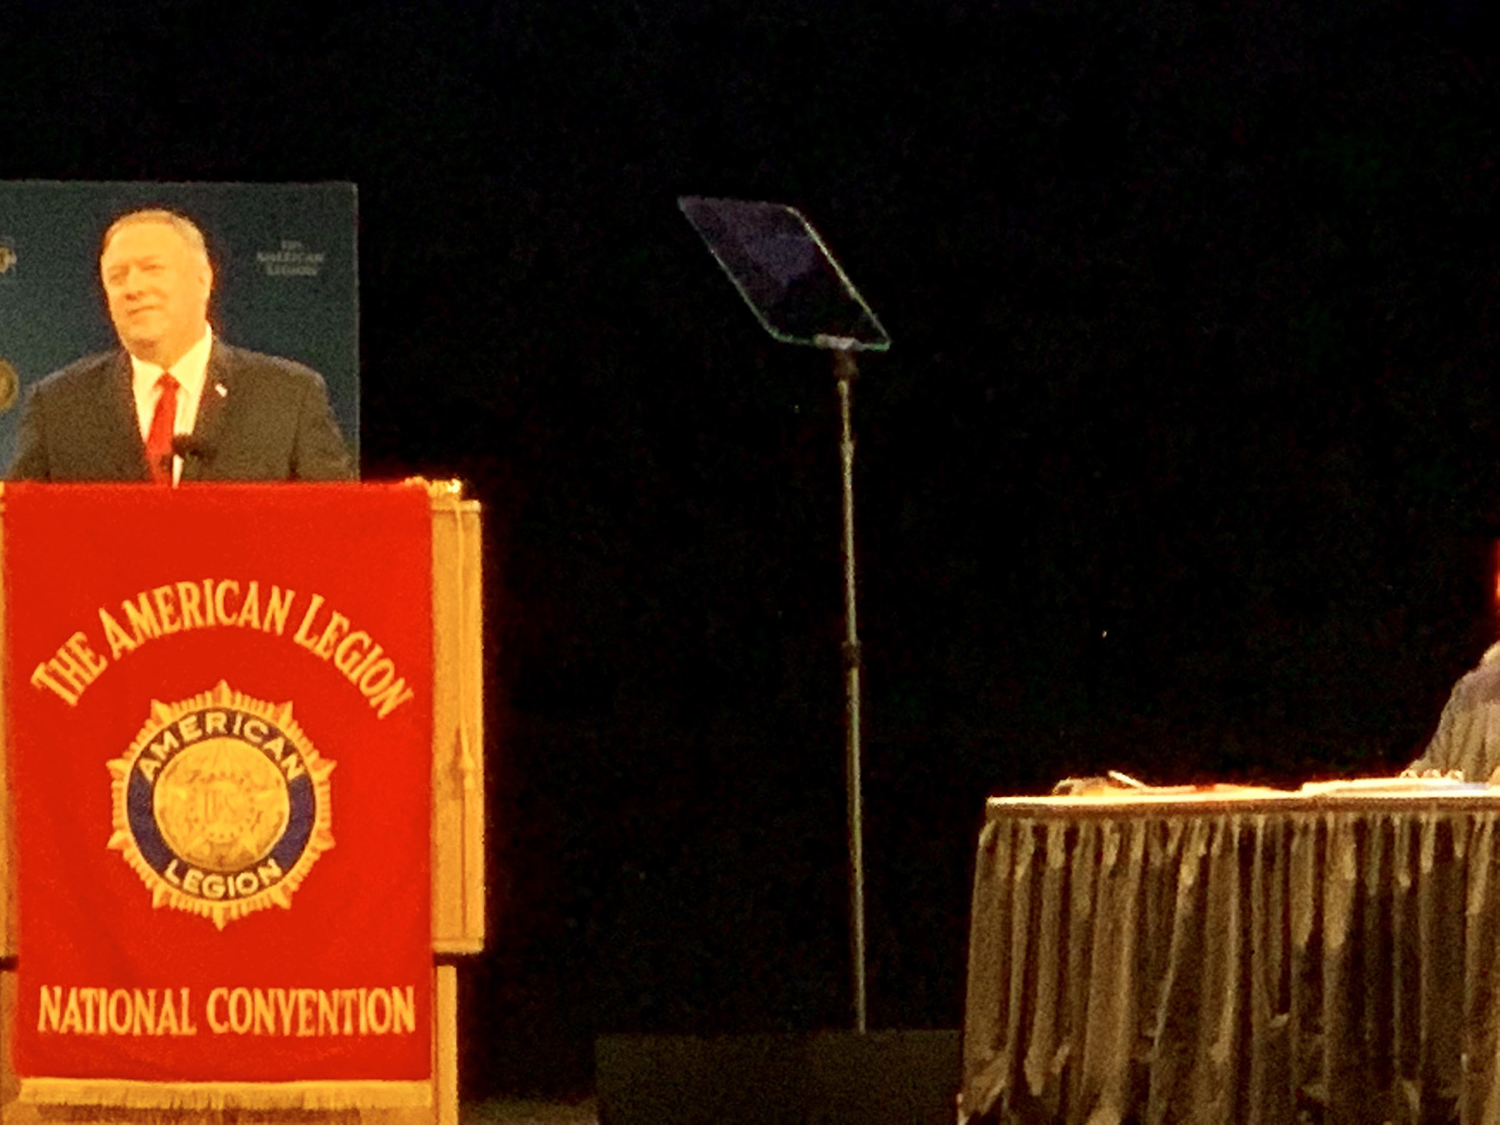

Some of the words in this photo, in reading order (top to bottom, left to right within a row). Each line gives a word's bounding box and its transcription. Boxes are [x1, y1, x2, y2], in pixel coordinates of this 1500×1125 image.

[31, 631, 108, 706] THE
[98, 578, 296, 661] AMERICAN
[293, 593, 414, 720] LEGION
[138, 712, 305, 782] AMERICAN
[164, 858, 284, 899] LEGION
[38, 985, 197, 1036] NATIONAL
[207, 987, 415, 1037] CONVENTION
